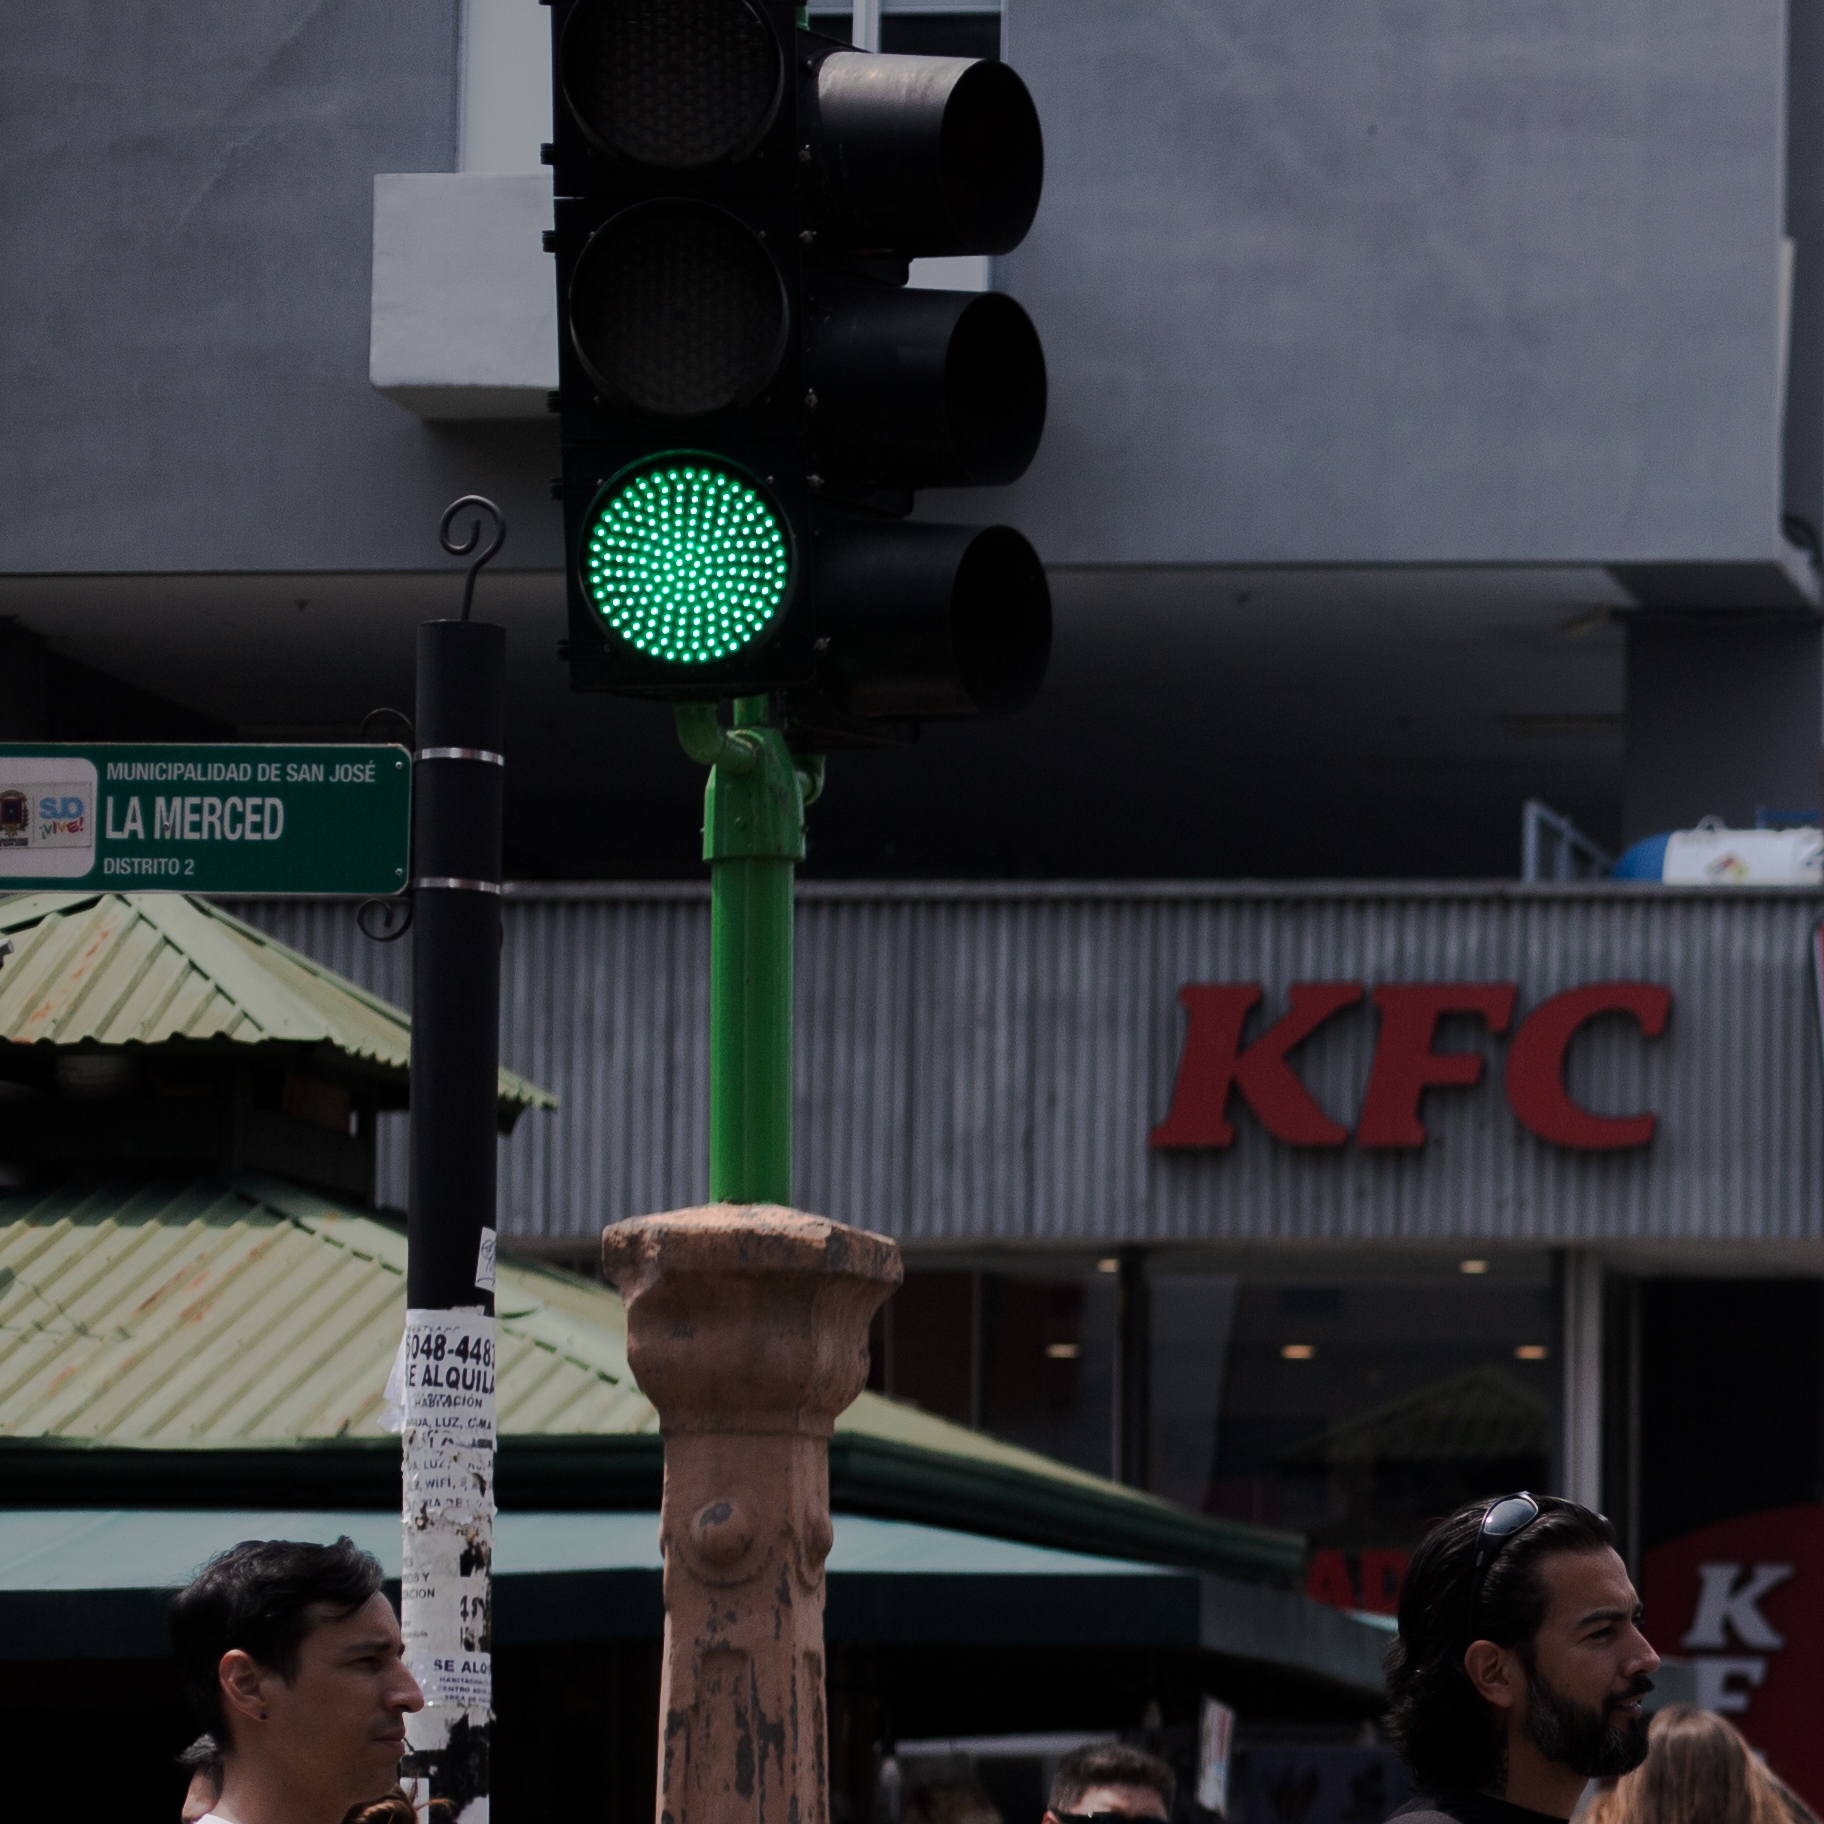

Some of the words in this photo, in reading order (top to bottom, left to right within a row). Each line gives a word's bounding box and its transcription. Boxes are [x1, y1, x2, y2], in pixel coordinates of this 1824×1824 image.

[106, 762, 251, 782] MUNICIPALIDAD
[257, 763, 282, 782] DE
[285, 763, 325, 783] SAN
[329, 760, 377, 783] JOSÉ
[105, 796, 145, 840] LA
[154, 796, 285, 841] MERCED
[103, 857, 180, 875] DISTRITO
[183, 858, 195, 875] 2
[1147, 981, 1673, 1151] KFC
